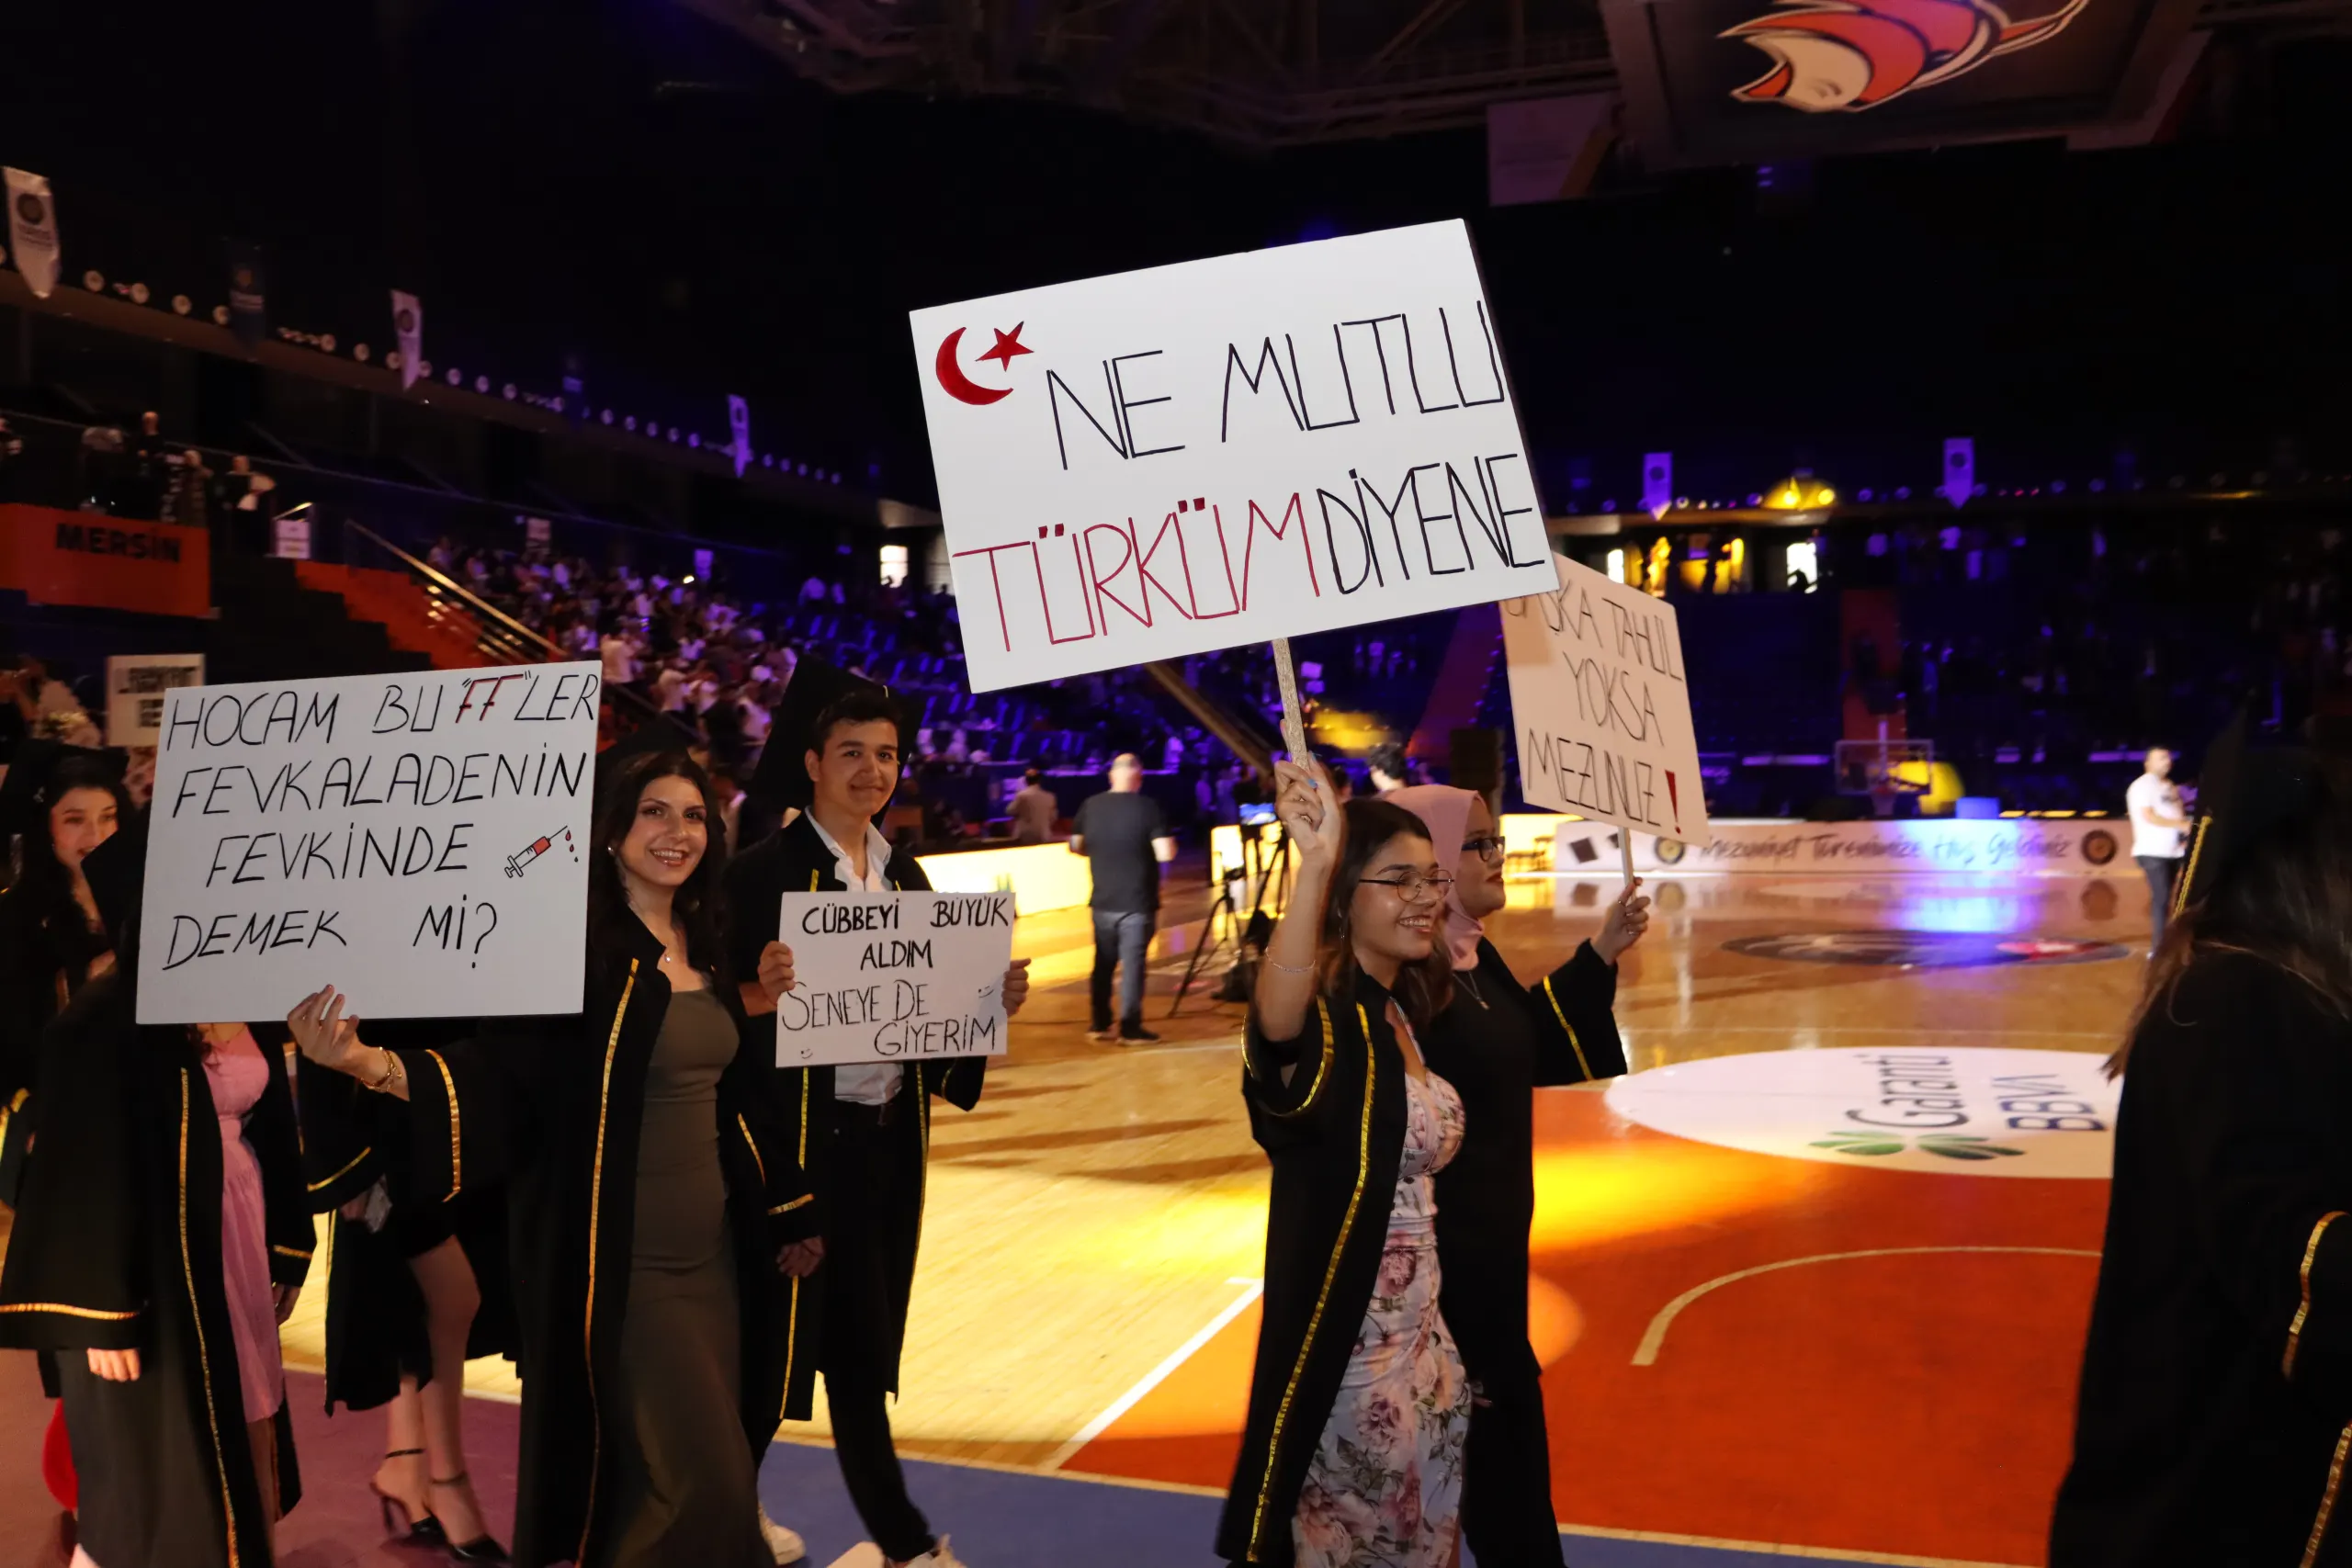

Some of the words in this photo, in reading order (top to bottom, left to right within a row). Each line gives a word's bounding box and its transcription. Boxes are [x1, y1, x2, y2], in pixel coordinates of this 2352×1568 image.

[1046, 349, 1186, 470] NE
[1221, 299, 1505, 443] MUTLU
[951, 491, 1320, 652] TÜRKÜM
[1316, 453, 1545, 595] DİYENE
[166, 691, 340, 751] HOCAM
[372, 684, 443, 733] BU
[1563, 650, 1665, 748] YOKSA
[172, 741, 587, 818] FEVKALADENİN
[206, 822, 474, 887] FEVKİNDE
[163, 909, 347, 971] DEMEK
[413, 894, 498, 969] Mİ?
[802, 897, 899, 935] CÜBBEYİ
[930, 895, 1009, 928] BÜYÜK
[860, 939, 933, 971] ALDIM
[782, 980, 882, 1032] SENEYE
[892, 979, 930, 1021] DE
[874, 1014, 996, 1056] GİYERİM
[1845, 1053, 1970, 1129] Garanti
[1990, 1073, 2109, 1133] BBVA
